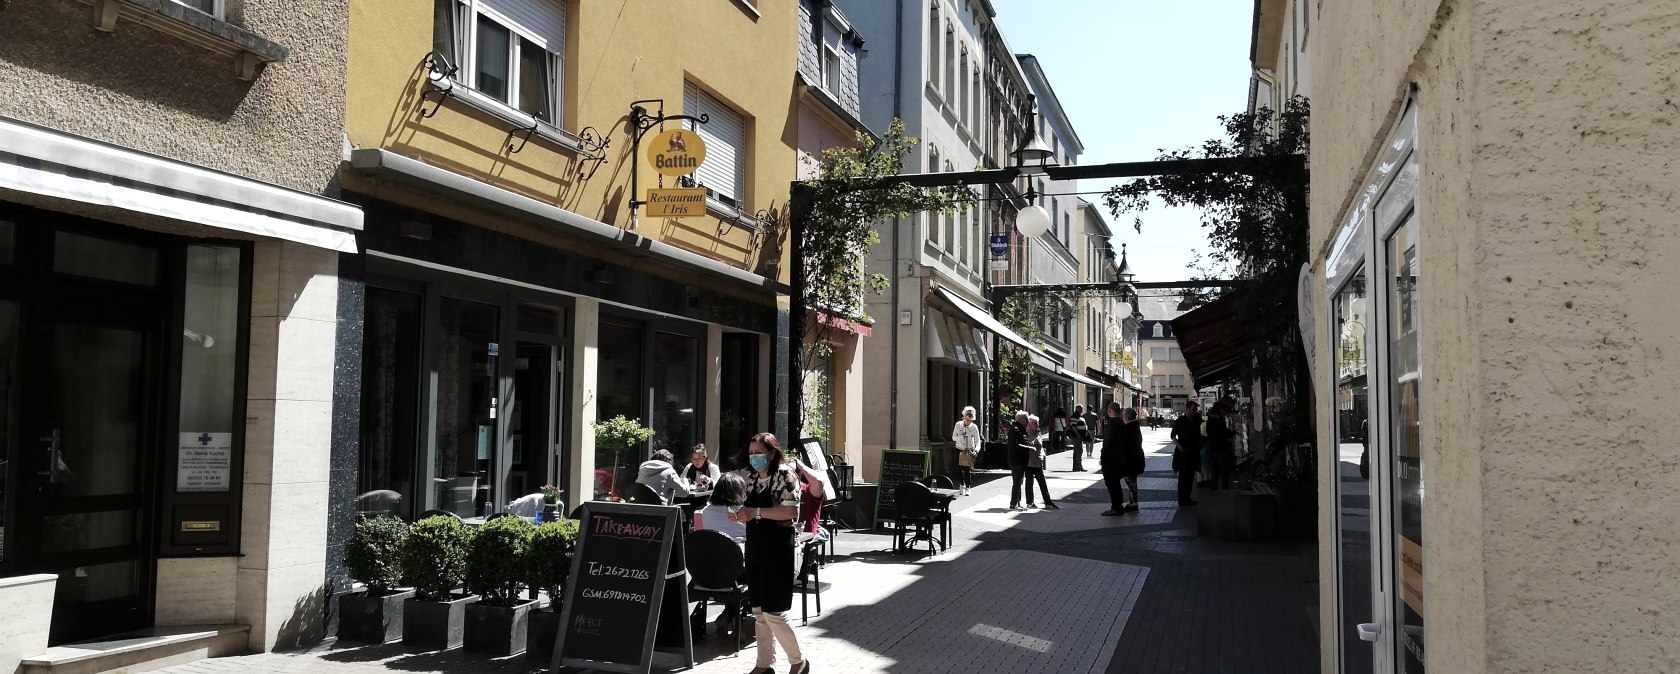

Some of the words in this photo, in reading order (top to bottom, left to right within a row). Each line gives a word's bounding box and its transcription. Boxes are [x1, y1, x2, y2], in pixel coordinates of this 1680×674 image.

[656, 154, 697, 169] Battin
[650, 193, 703, 203] Restaurant
[593, 515, 661, 544] TAKEAWAY
